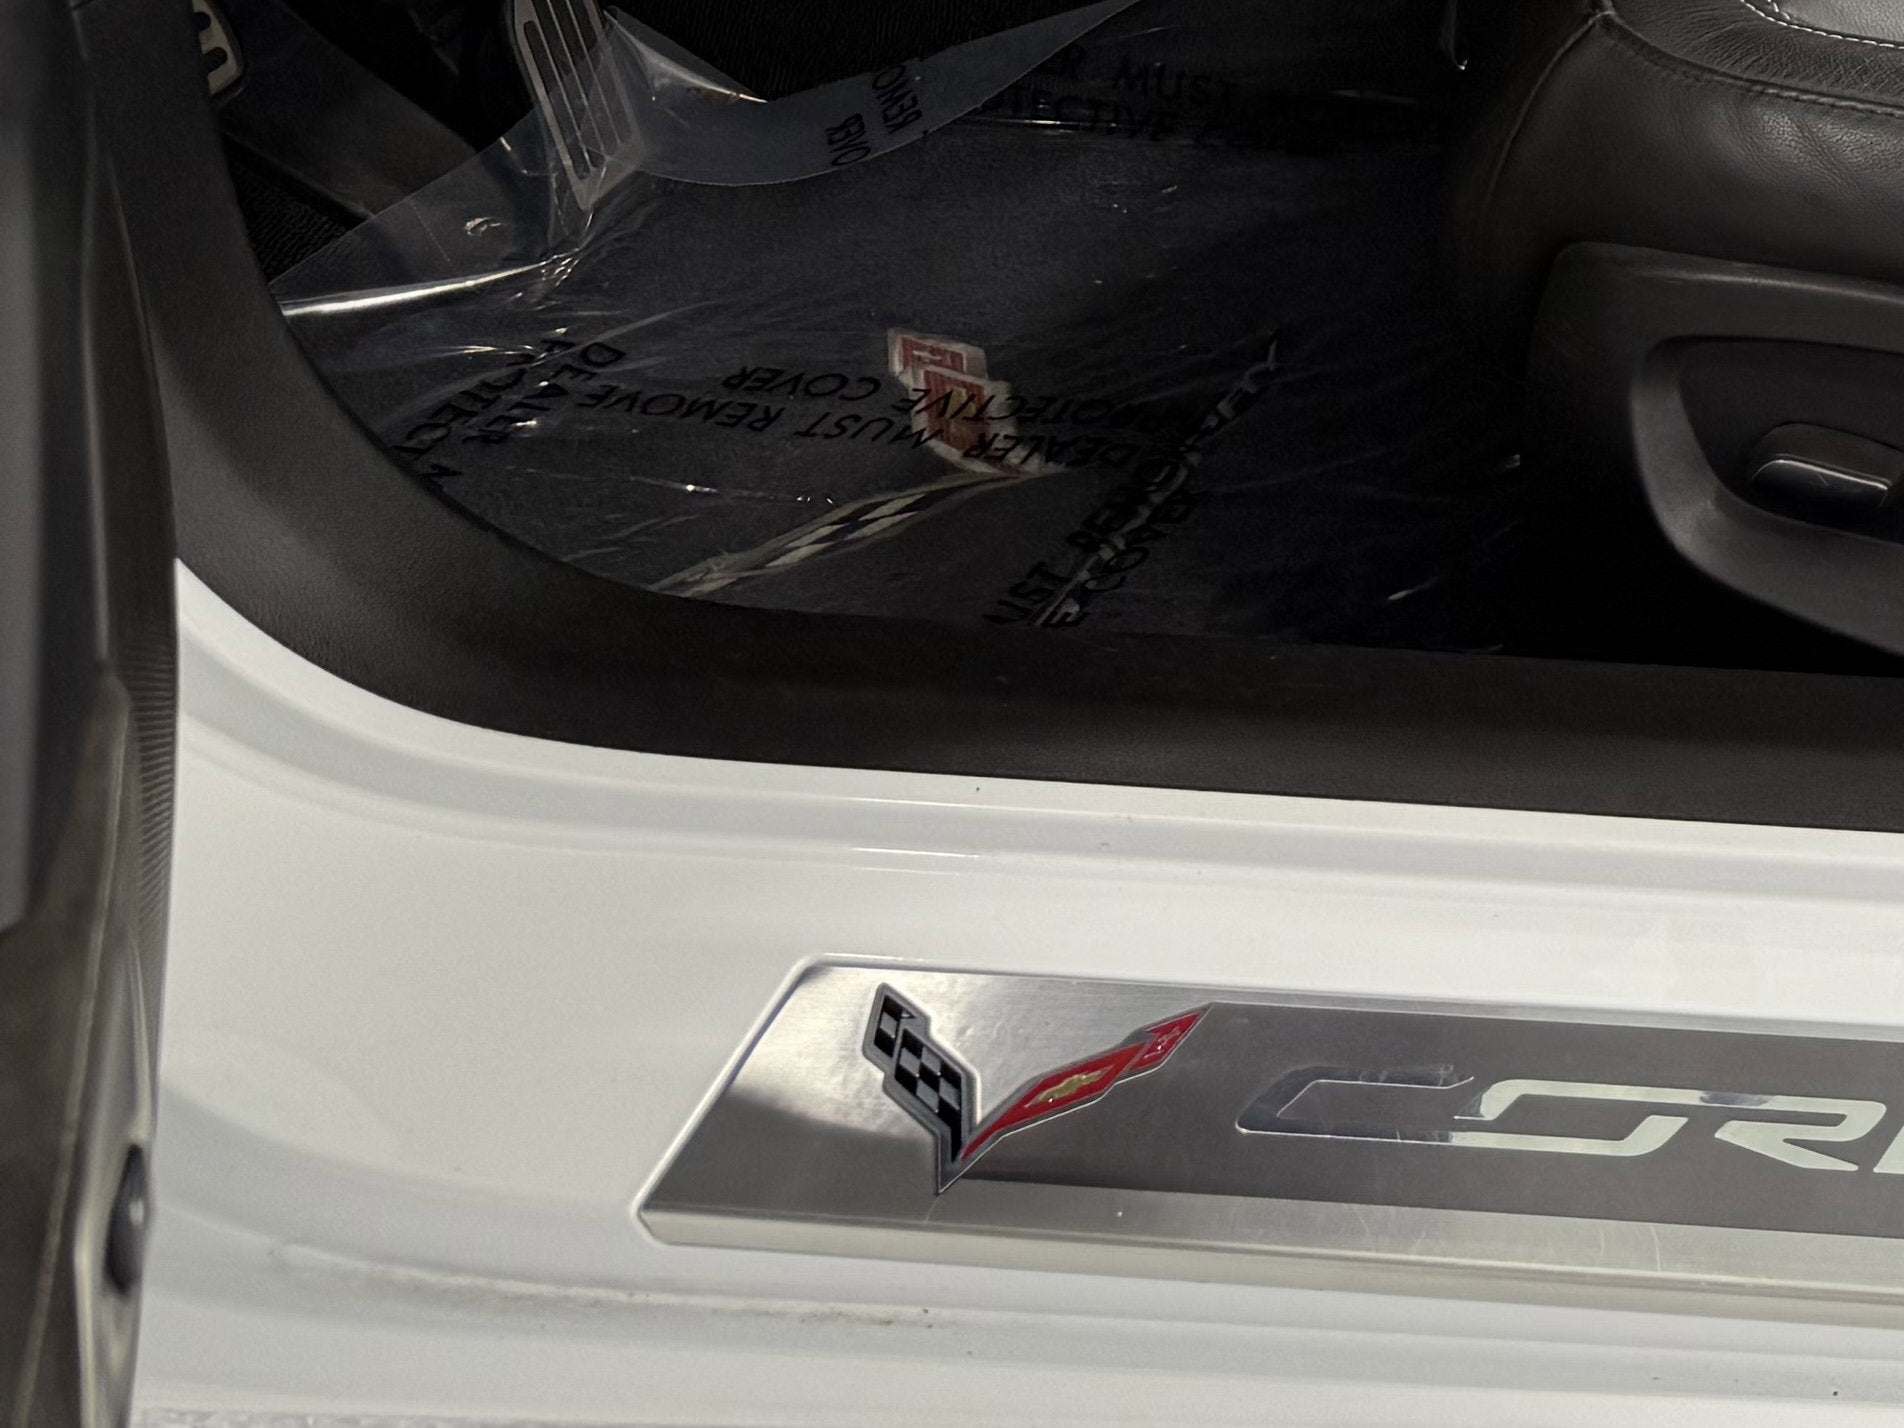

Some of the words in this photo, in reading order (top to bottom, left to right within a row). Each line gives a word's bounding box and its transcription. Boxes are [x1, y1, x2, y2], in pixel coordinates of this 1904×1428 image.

[720, 365, 881, 404] COVER
[575, 384, 783, 434] REMOVE
[793, 410, 945, 450] MUST
[963, 432, 1141, 469] DEALER
